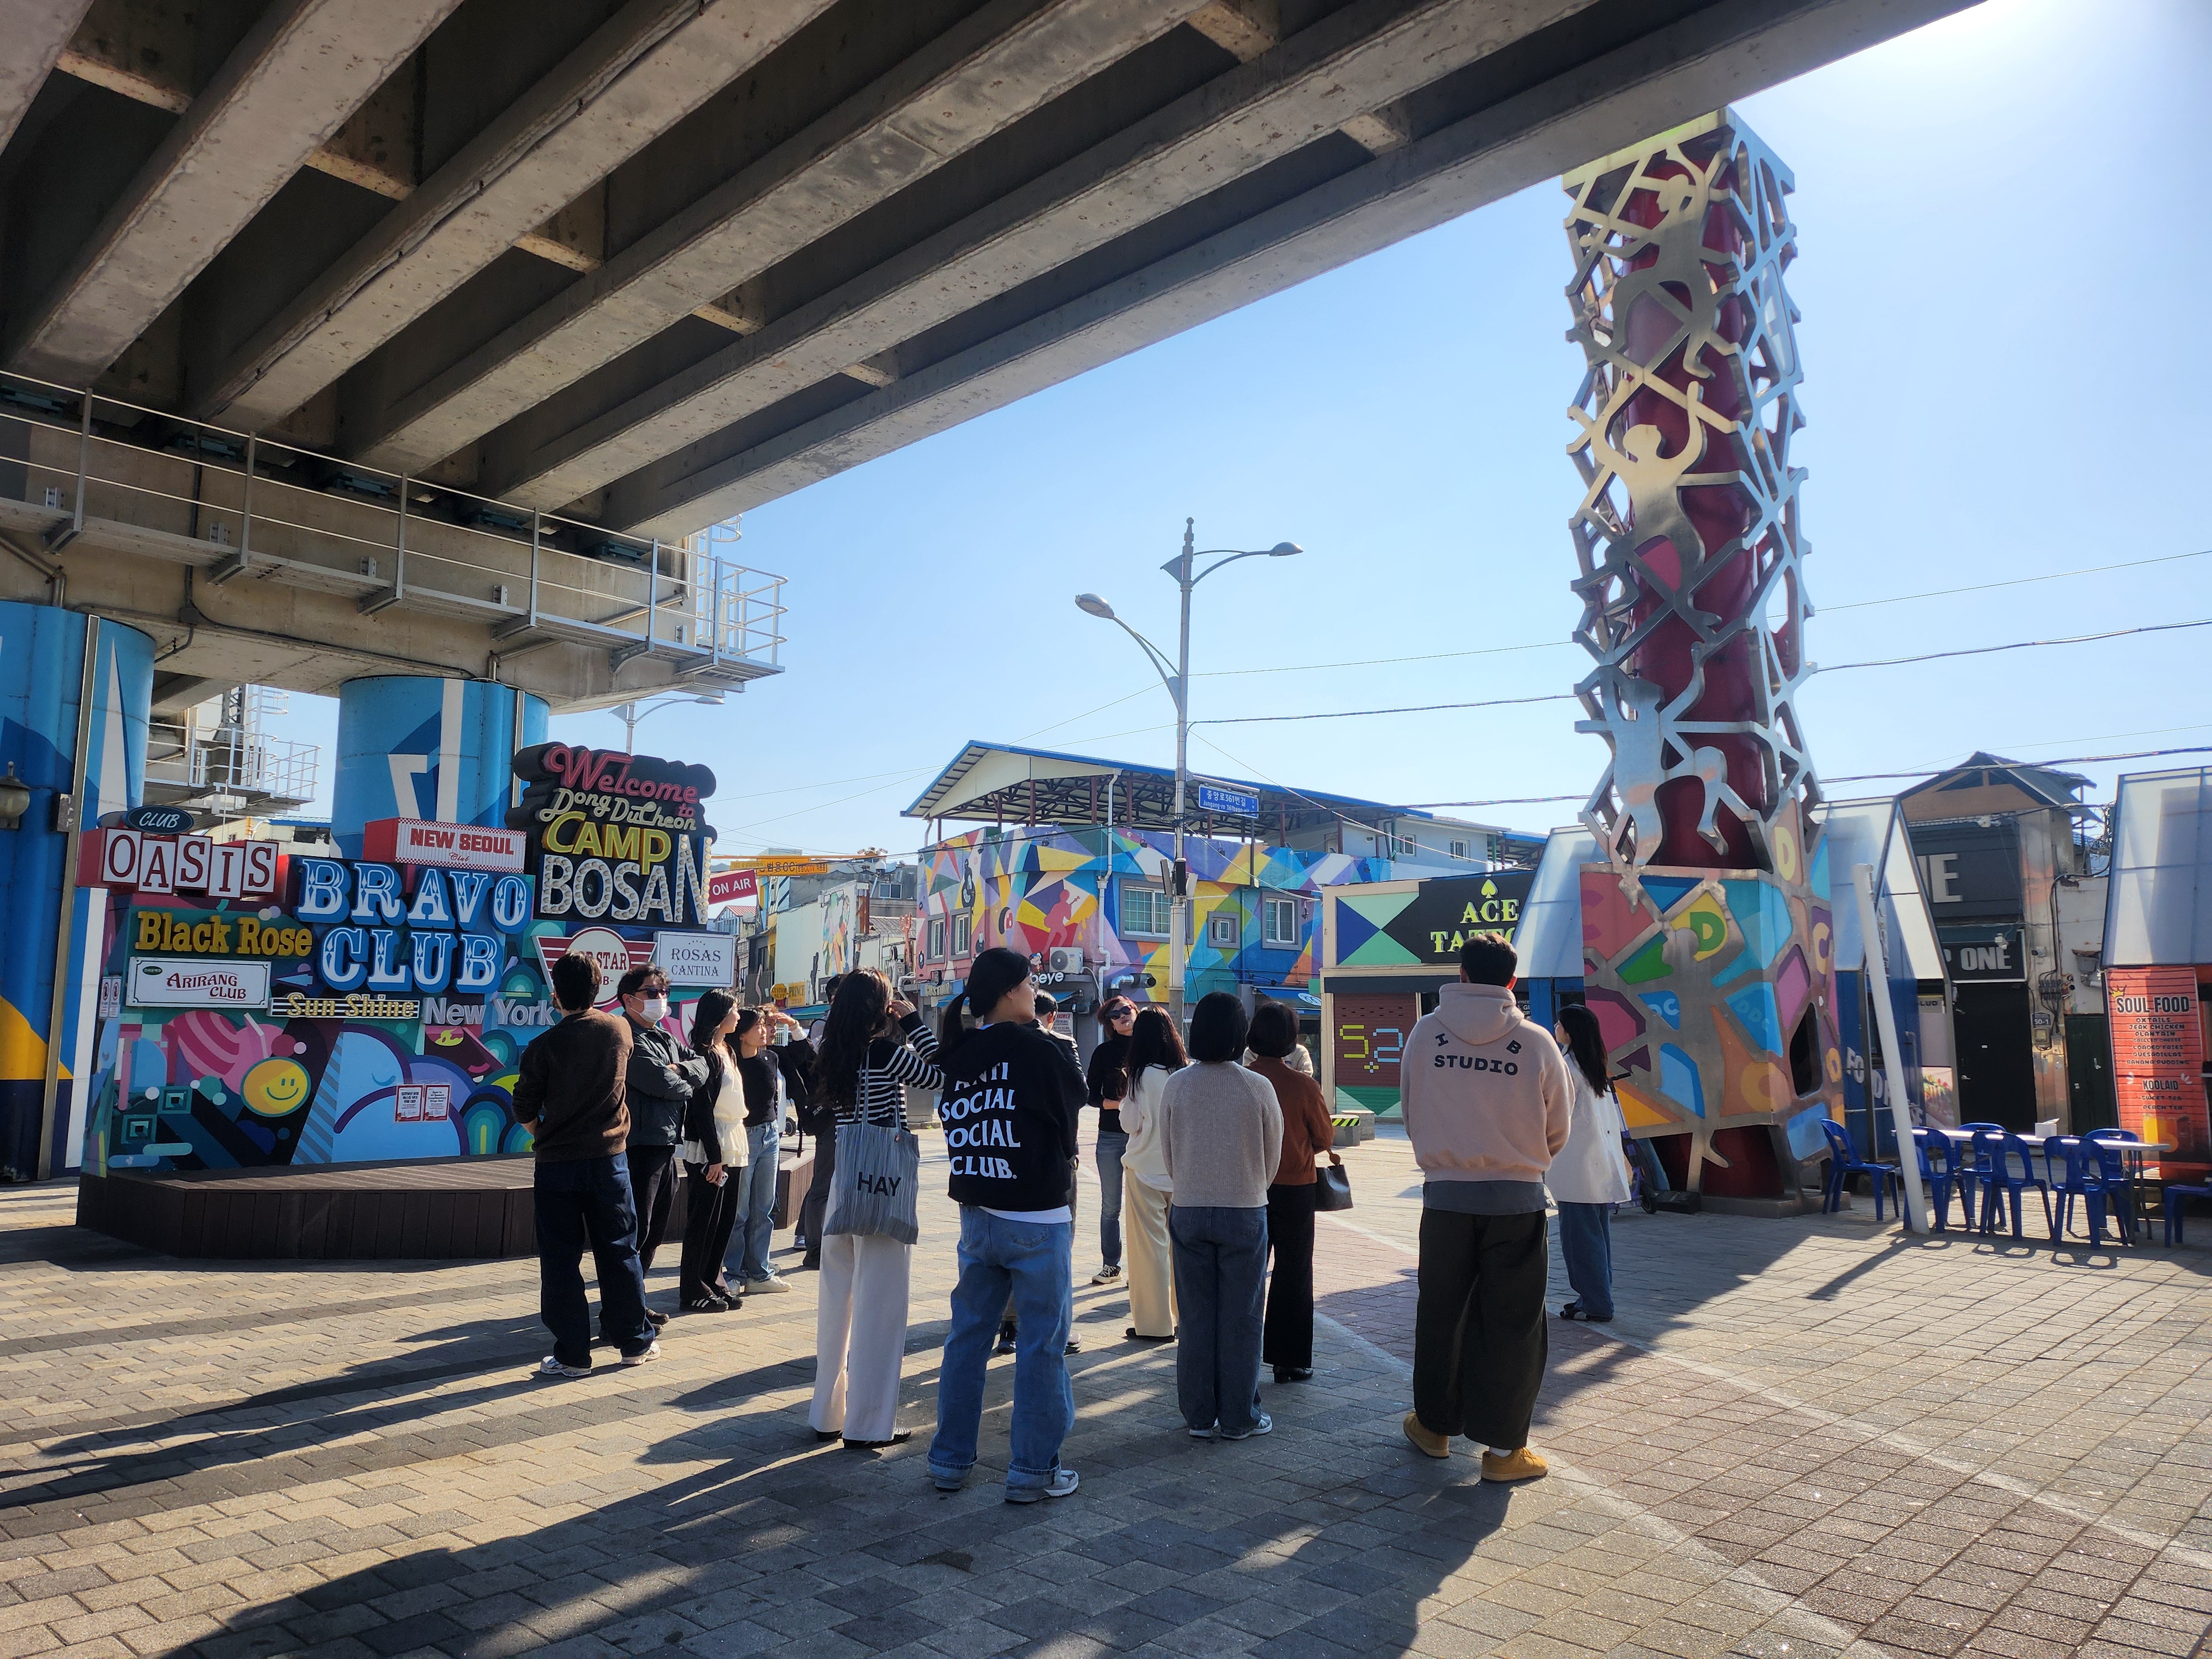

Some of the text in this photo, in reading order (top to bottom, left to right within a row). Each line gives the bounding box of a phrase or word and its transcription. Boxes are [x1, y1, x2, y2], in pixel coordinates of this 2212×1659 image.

[544, 744, 699, 804] Welcome
[540, 788, 612, 822] Dong
[1203, 800, 1226, 810] Jungang-ro
[1206, 790, 1246, 807] 중앙로361번길
[138, 811, 180, 828] CLUB
[679, 804, 695, 818] to
[410, 828, 514, 855] NEW SEOUL
[542, 812, 671, 875] CAMP
[108, 834, 272, 893] OASIS
[448, 852, 469, 862] Club
[540, 834, 713, 925] BOSAN
[712, 878, 752, 896] ON AIR
[296, 858, 531, 933] BRAVO
[1460, 899, 1520, 924] ACE
[135, 911, 312, 957] Black Rose
[322, 927, 499, 989] CLUB
[597, 952, 627, 971] STAR
[671, 948, 721, 962] ROSAS
[1960, 946, 2012, 971] ONE
[166, 972, 238, 989] ARIRANG
[671, 964, 719, 977] CANTINA
[209, 986, 247, 1000] CLUB
[789, 985, 805, 998] PRINCE
[286, 992, 415, 1018] Sun Shine
[423, 997, 555, 1027] New York
[2116, 996, 2190, 1013] SOUL FOOD
[1434, 1054, 1518, 1076] STUDIO
[2143, 1080, 2179, 1091] KOOLAID
[941, 1088, 1016, 1122] SOCIAL
[857, 1171, 902, 1197] HAY
